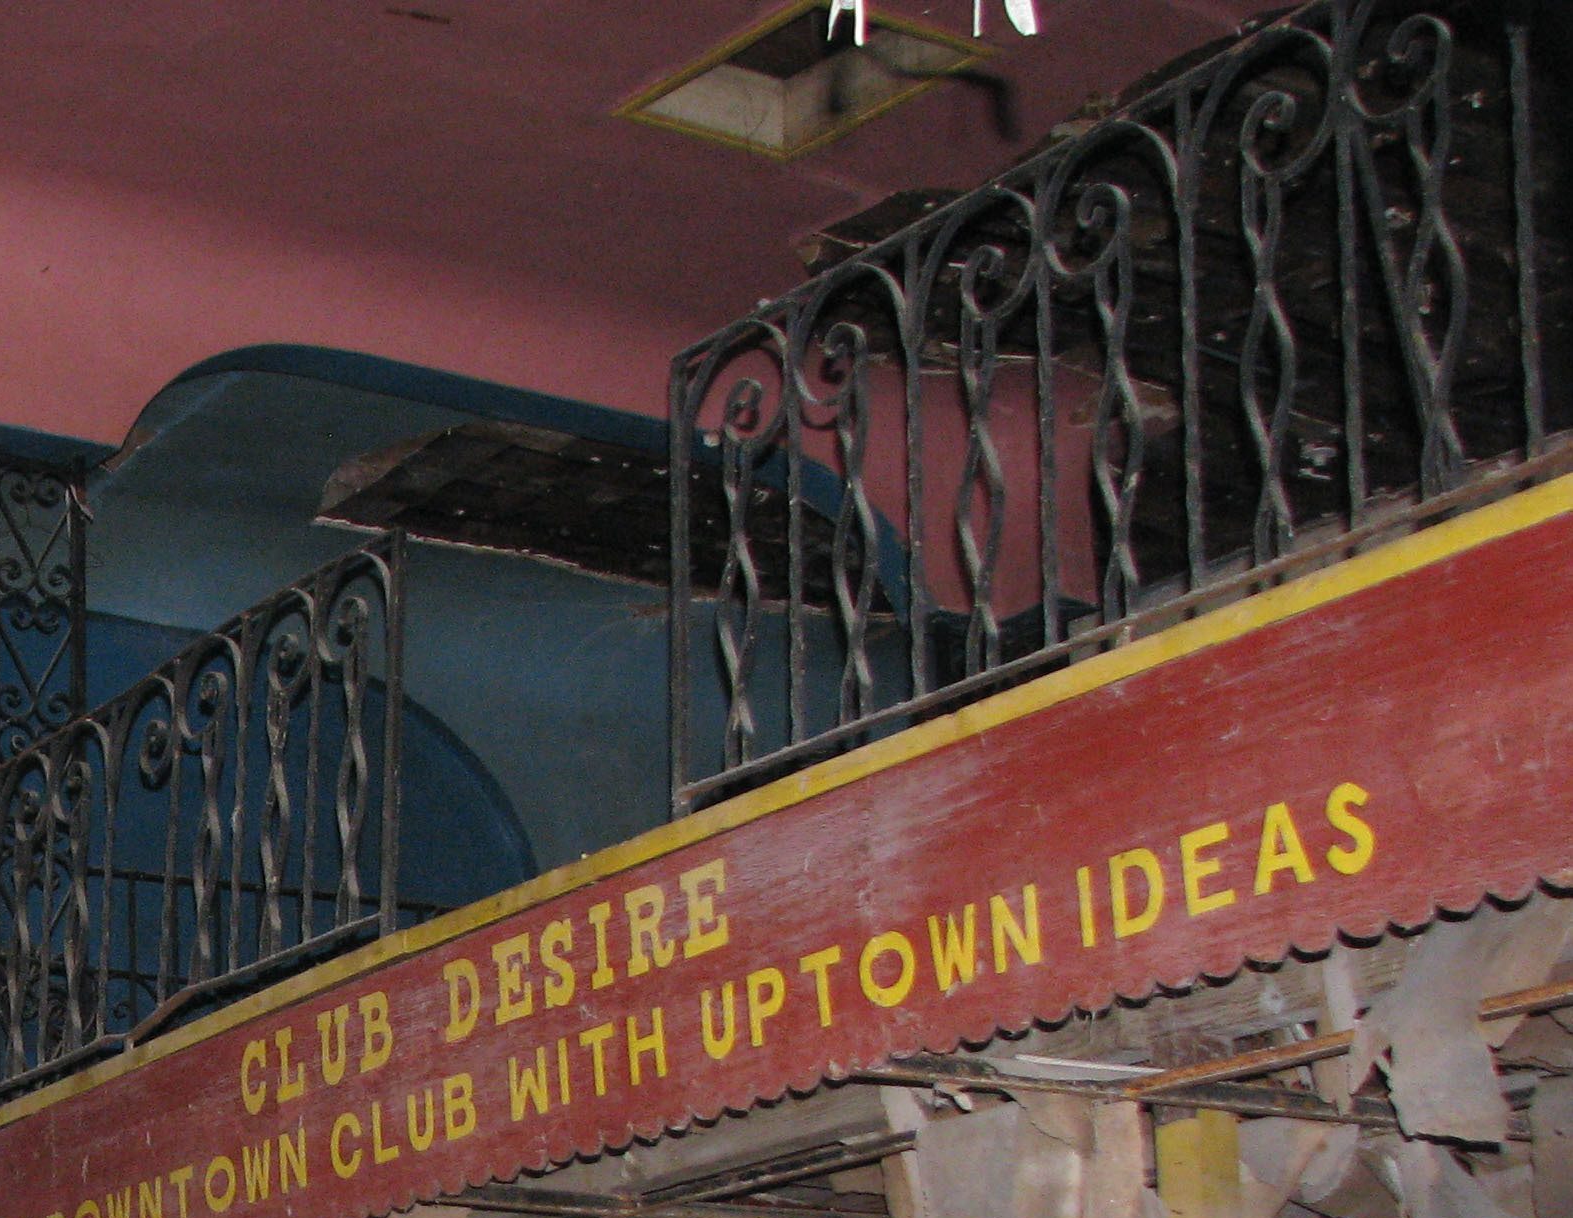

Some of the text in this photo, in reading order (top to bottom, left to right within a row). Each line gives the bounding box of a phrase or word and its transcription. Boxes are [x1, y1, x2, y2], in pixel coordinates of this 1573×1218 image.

[240, 857, 732, 1116] CLUB DESIRE
[329, 1071, 480, 1181] CLUB
[506, 1006, 672, 1123] WITH
[698, 882, 1045, 1062] UPTOWN
[1073, 780, 1376, 950] IDEAS
